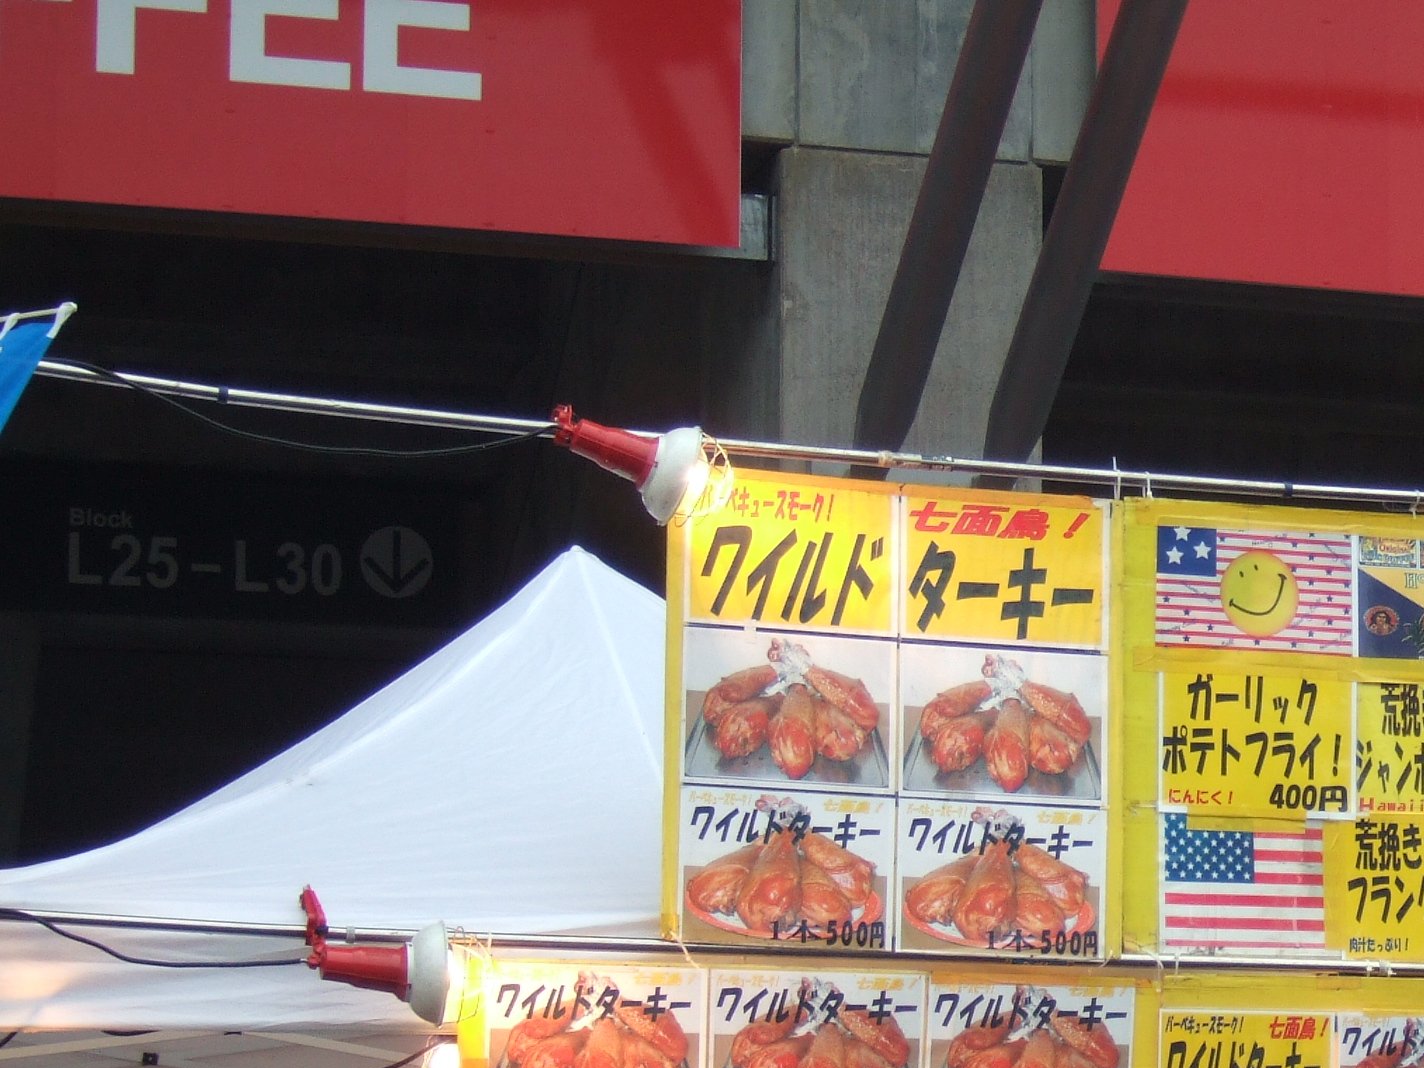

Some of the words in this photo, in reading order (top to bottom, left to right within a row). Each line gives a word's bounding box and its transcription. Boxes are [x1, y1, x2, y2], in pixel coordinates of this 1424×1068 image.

[69, 507, 133, 529] Block
[701, 526, 885, 626] ワイルド
[909, 541, 1094, 639] ターキー
[1188, 673, 1318, 725] ガーリック
[1163, 725, 1342, 781] ポテトフライ!
[1168, 788, 1233, 805] にんにく!
[1269, 784, 1348, 812] 400円
[690, 806, 881, 849] ワイルドターキー
[908, 817, 1094, 860] ワイルドターキー
[769, 921, 885, 949] 1本500円
[986, 929, 1098, 958] 1本500円
[499, 984, 692, 1020] ワイルドターキー
[716, 987, 918, 1026] ワイルドターキー
[934, 992, 1127, 1032] ワイルドターキー
[1268, 1017, 1329, 1040] 七面鳥!
